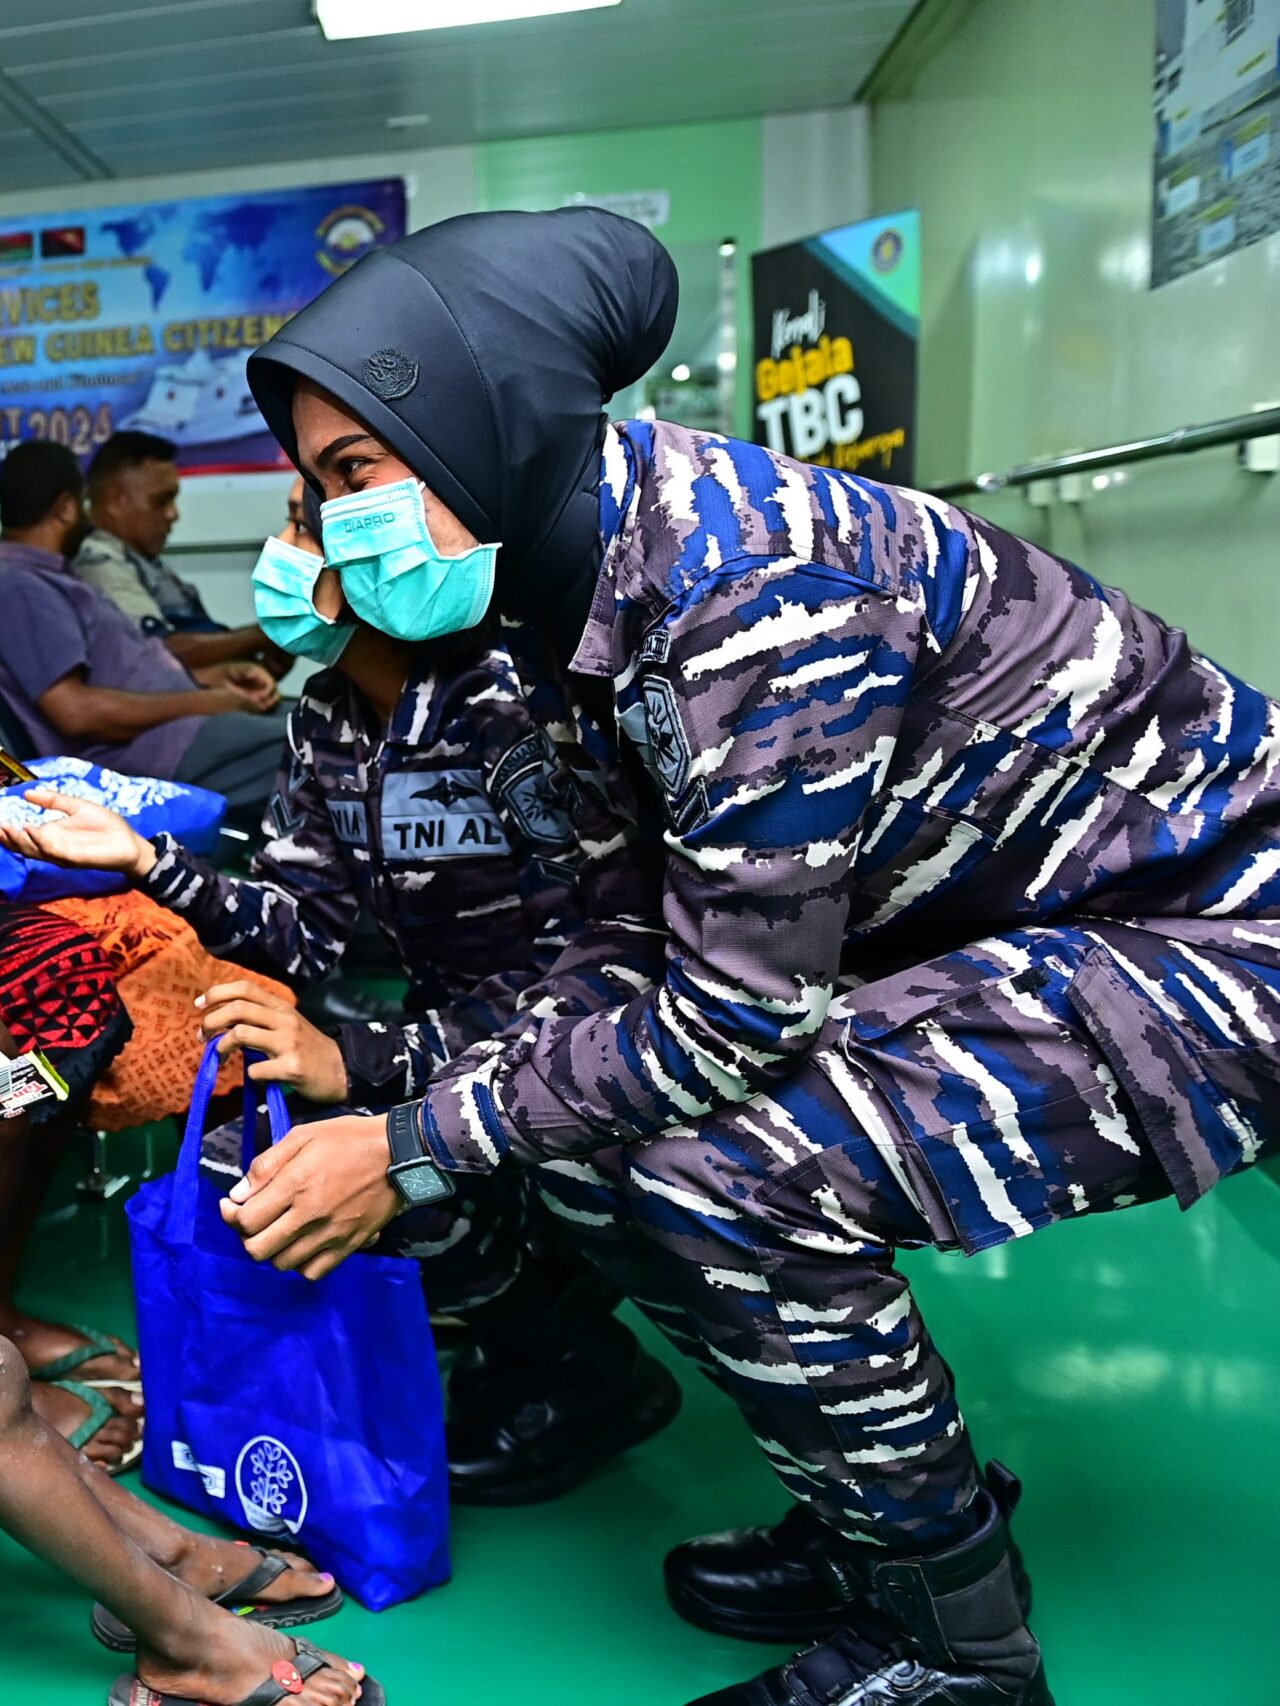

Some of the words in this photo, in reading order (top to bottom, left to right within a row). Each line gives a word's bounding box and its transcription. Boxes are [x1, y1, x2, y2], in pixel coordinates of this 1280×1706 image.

[45, 323, 154, 363] GUINEA
[163, 310, 297, 351] CITIZEN
[757, 373, 865, 458] TBC
[393, 819, 446, 850] TNI
[458, 818, 502, 845] AL
[12, 1082, 46, 1099] Tan
